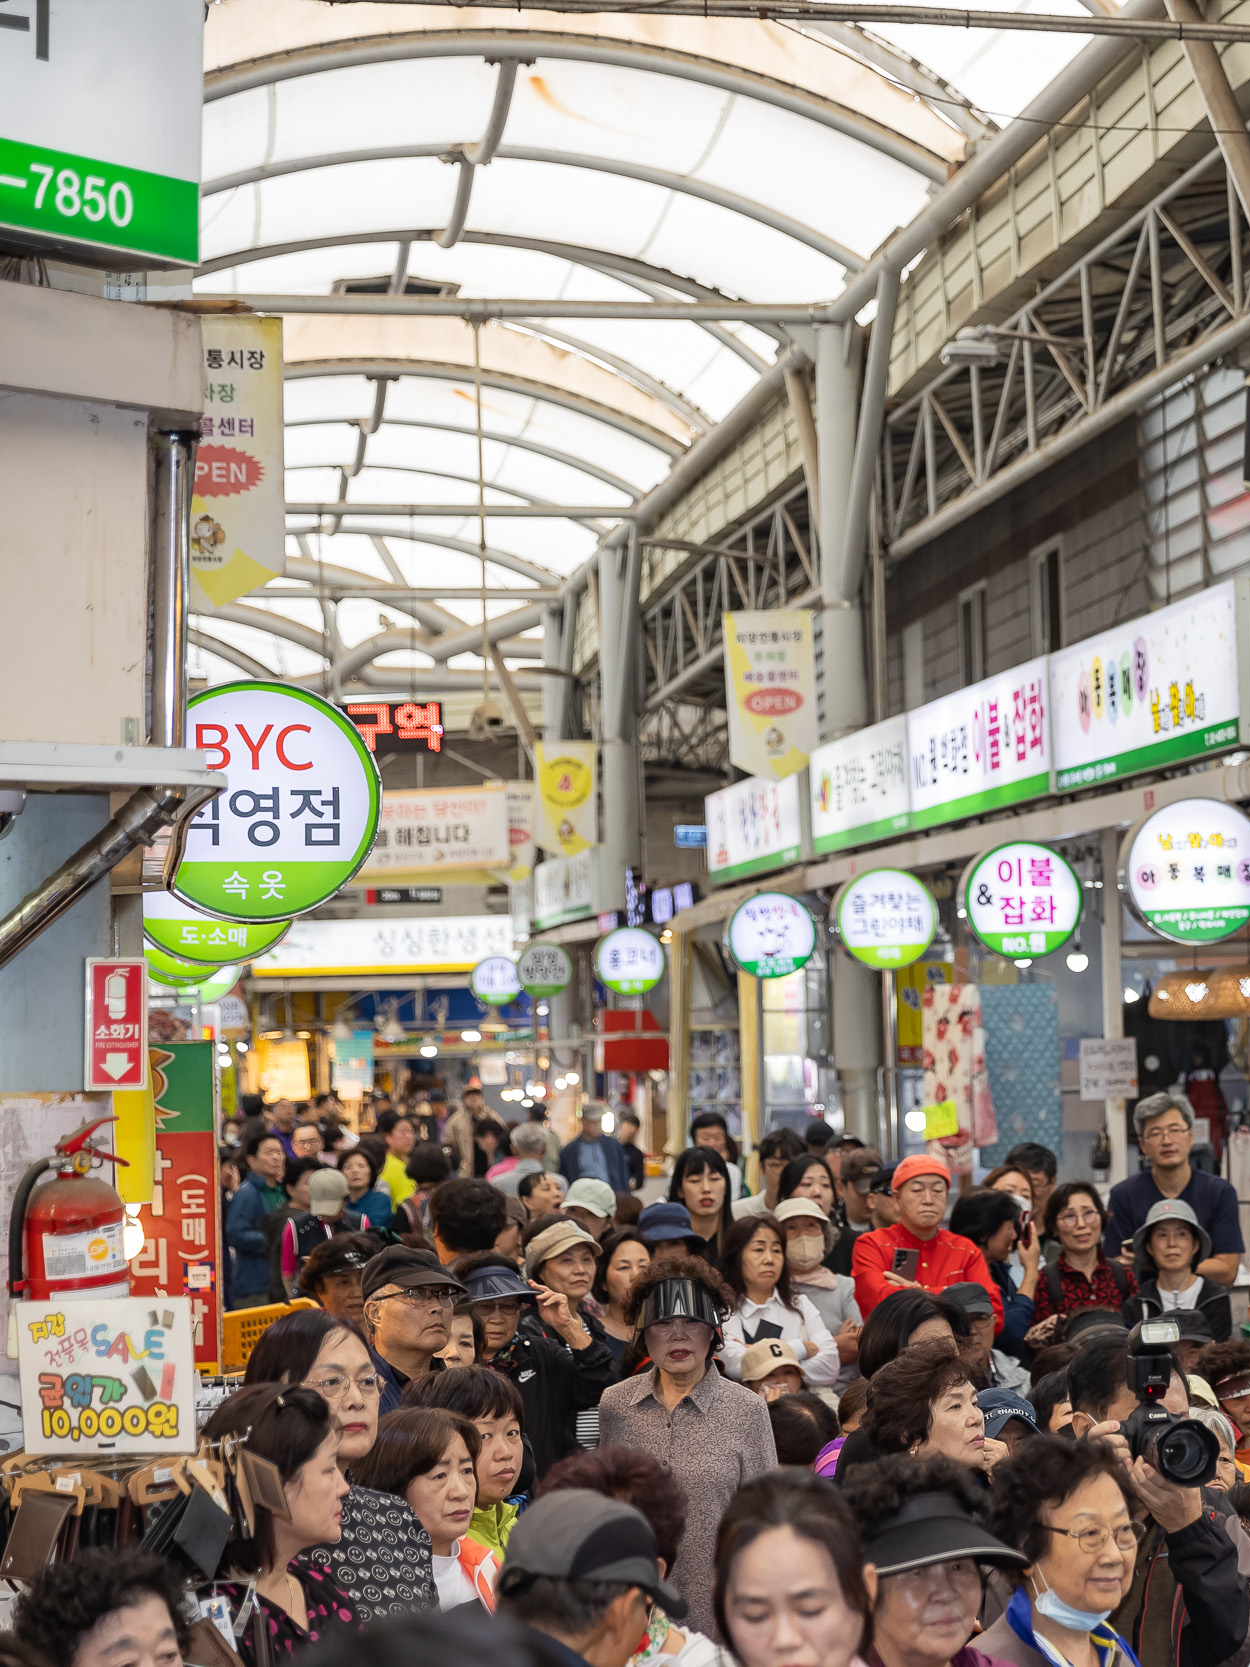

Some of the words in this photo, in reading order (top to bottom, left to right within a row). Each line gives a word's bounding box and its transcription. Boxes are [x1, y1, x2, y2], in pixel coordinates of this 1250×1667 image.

[751, 695, 797, 711] OPEN
[195, 723, 314, 771] BYC
[348, 702, 443, 752] 구역
[998, 858, 1054, 887] 이불
[977, 884, 993, 906] &
[1000, 895, 1057, 925] 잡화
[95, 1024, 139, 1039] 소화기
[176, 1174, 209, 1260] (도매)
[91, 1323, 165, 1364] SALE
[769, 1343, 782, 1357] C
[38, 1372, 127, 1409] 균일가
[41, 1401, 179, 1442] 10,000원
